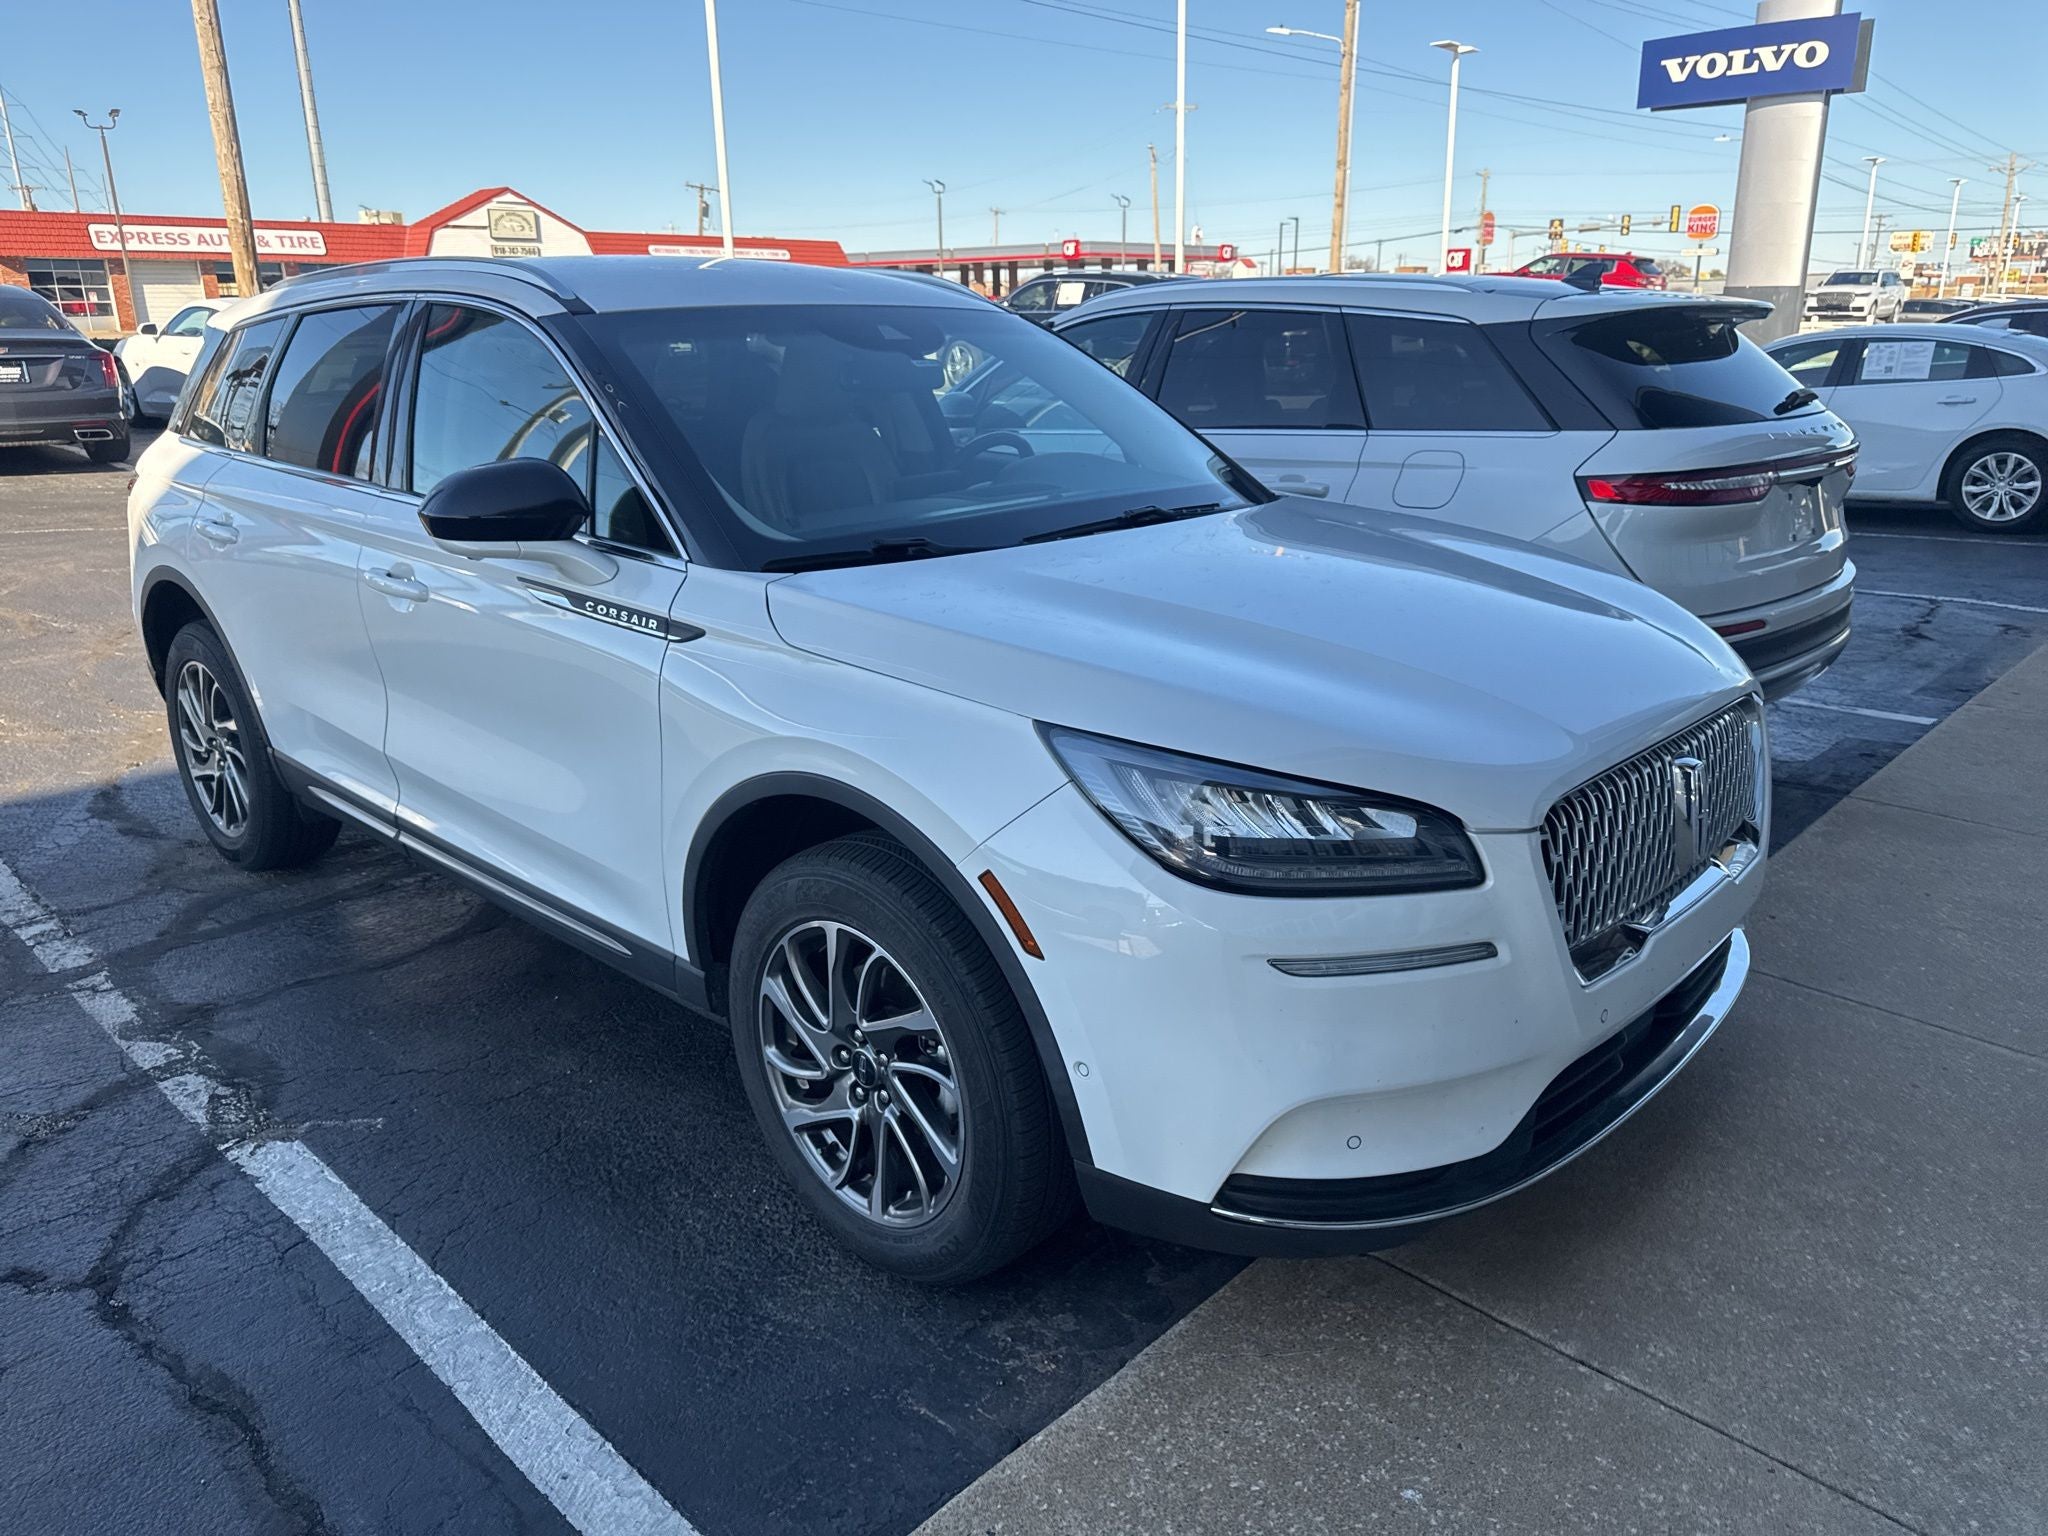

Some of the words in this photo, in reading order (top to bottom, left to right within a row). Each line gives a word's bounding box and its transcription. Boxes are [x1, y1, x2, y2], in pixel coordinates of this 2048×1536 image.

[1660, 40, 1830, 83] VOLVO
[1687, 222, 1716, 233] KING
[94, 230, 190, 246] EXPRESS
[197, 232, 232, 247] AU
[256, 235, 271, 248] &
[274, 235, 322, 248] TIRE
[1447, 250, 1467, 268] QT
[585, 601, 658, 630] CORSAIR
